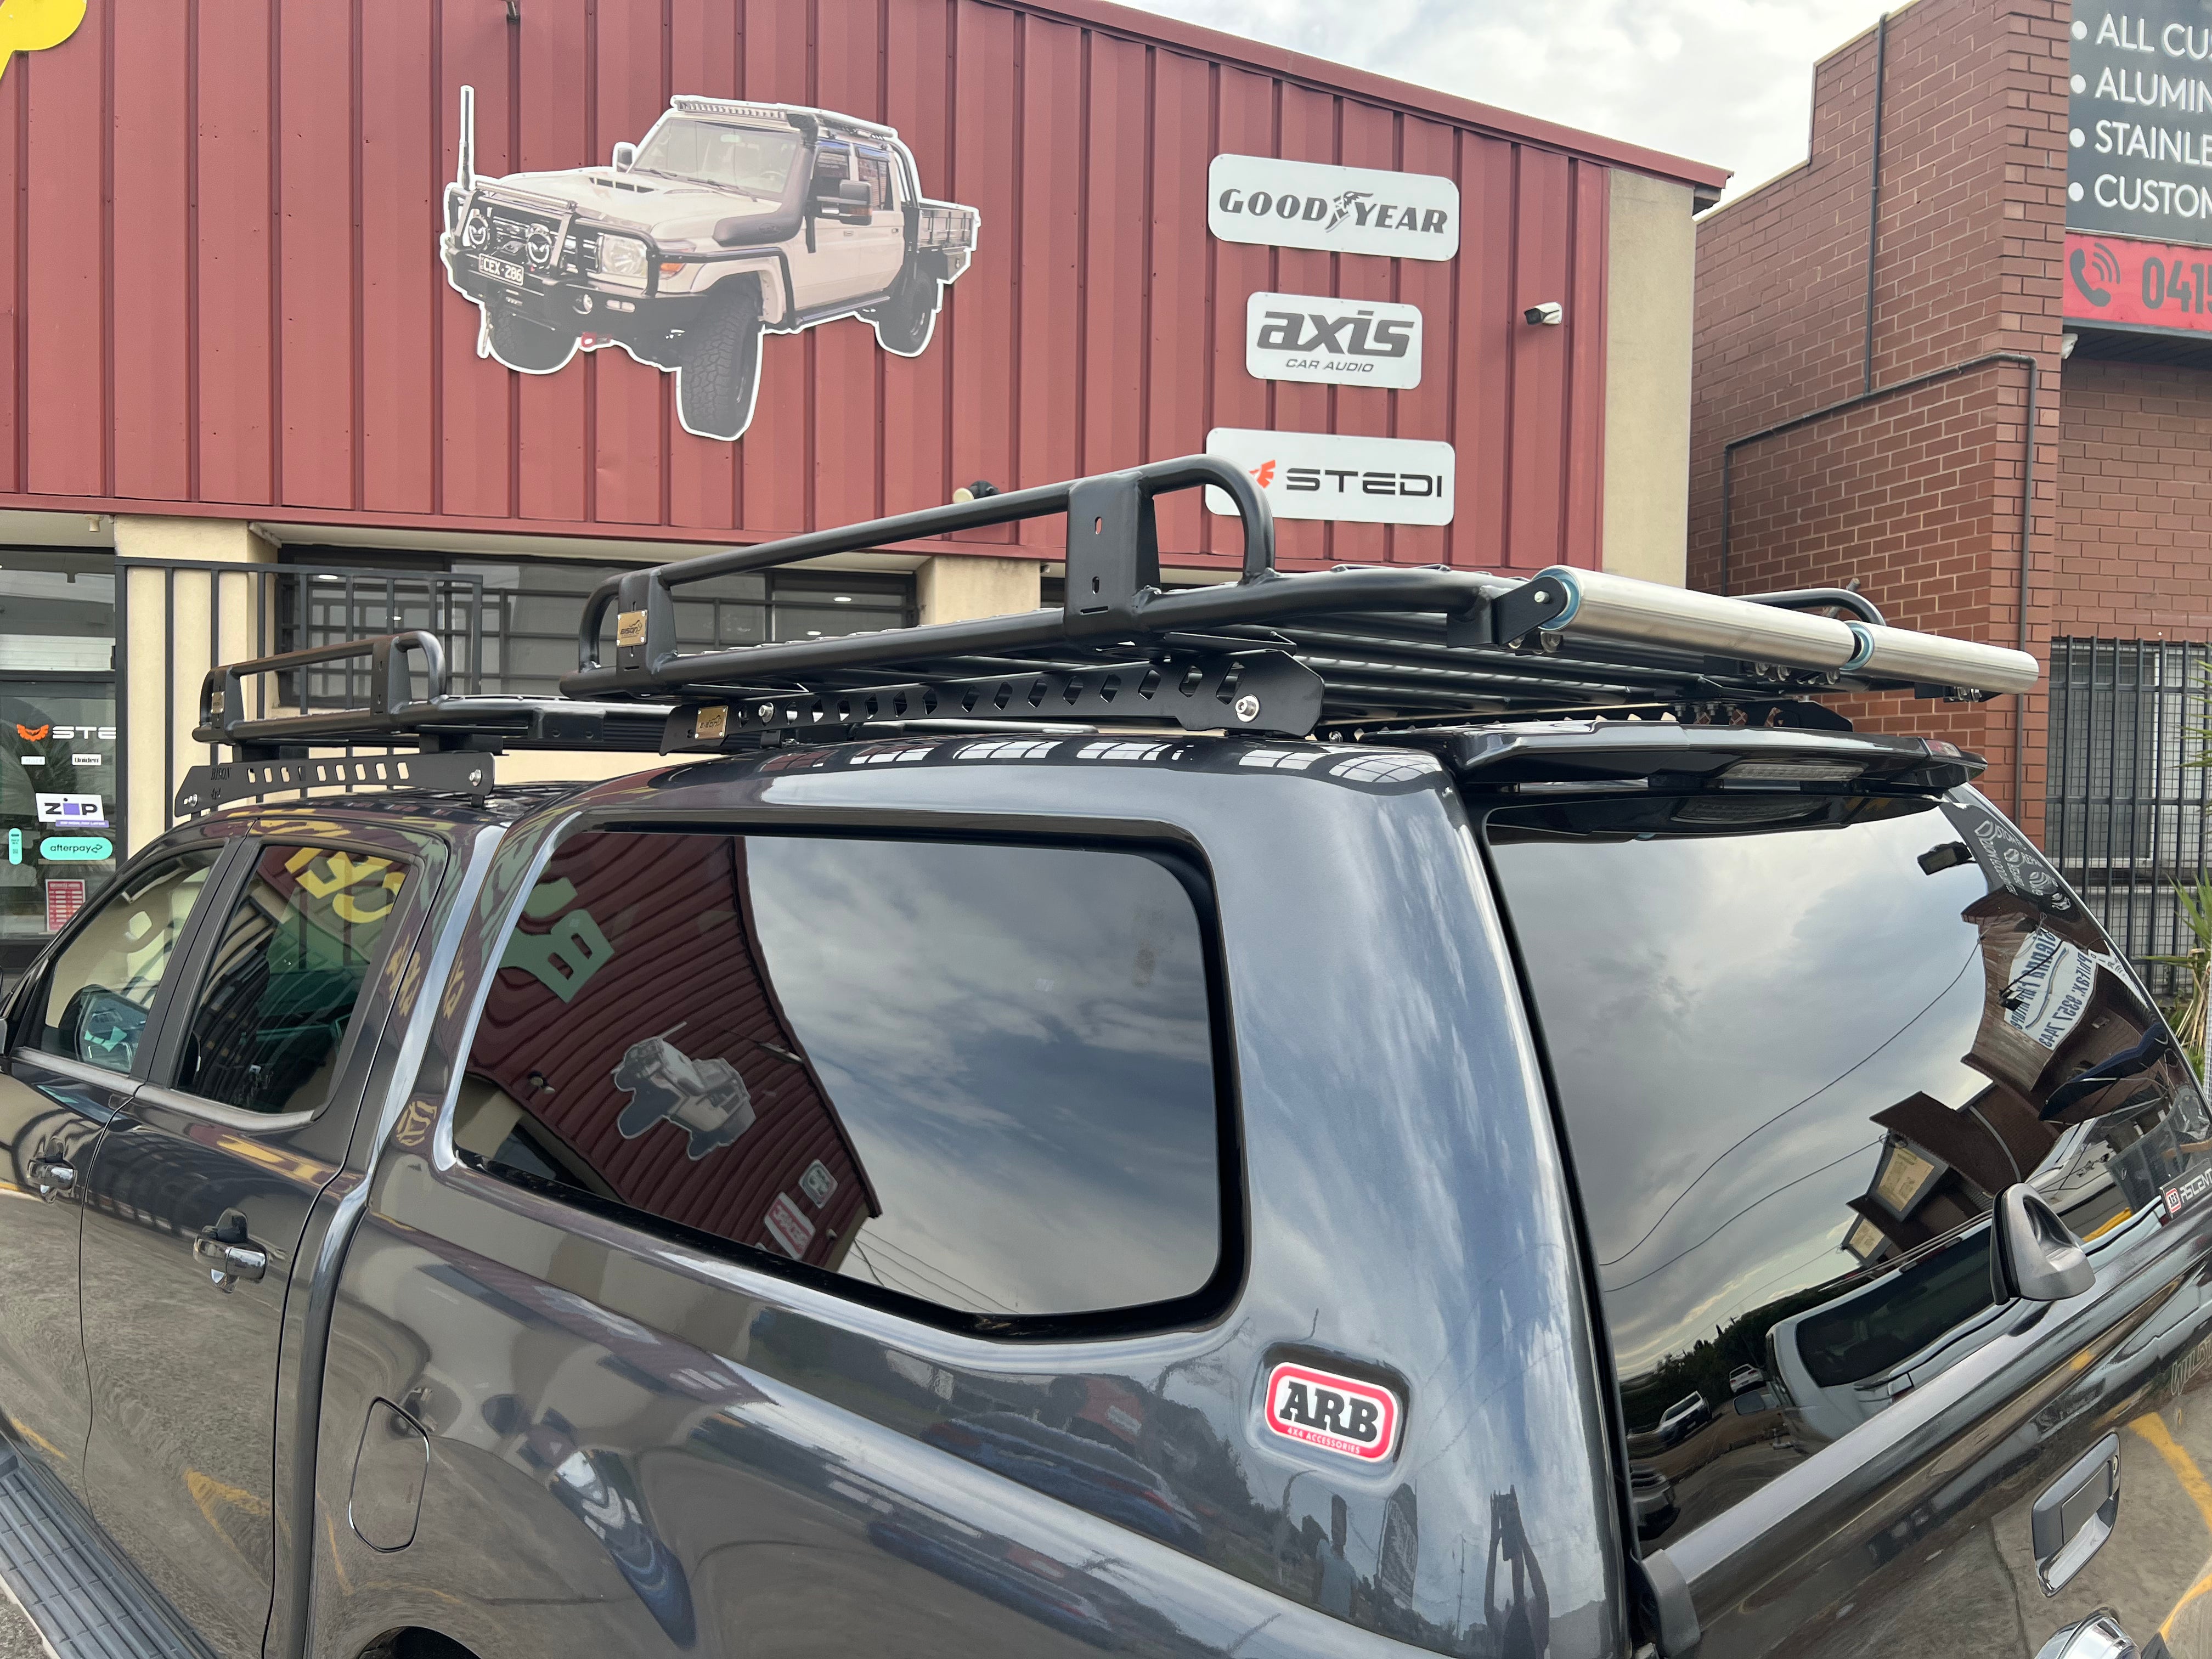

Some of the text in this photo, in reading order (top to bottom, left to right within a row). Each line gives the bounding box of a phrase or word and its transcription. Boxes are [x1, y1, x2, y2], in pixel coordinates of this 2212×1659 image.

[2096, 13, 2212, 61] ALL CU
[2095, 119, 2212, 166] STAINLE
[2142, 256, 2212, 315] 041
[1257, 310, 1415, 358] axis
[1286, 358, 1374, 373] CAR AUDIO
[1286, 467, 1442, 498] STEDI
[50, 844, 92, 854] afterpay
[1279, 1381, 1378, 1443] ARB
[1287, 1426, 1361, 1454] 4X4 ACCESSORIES
